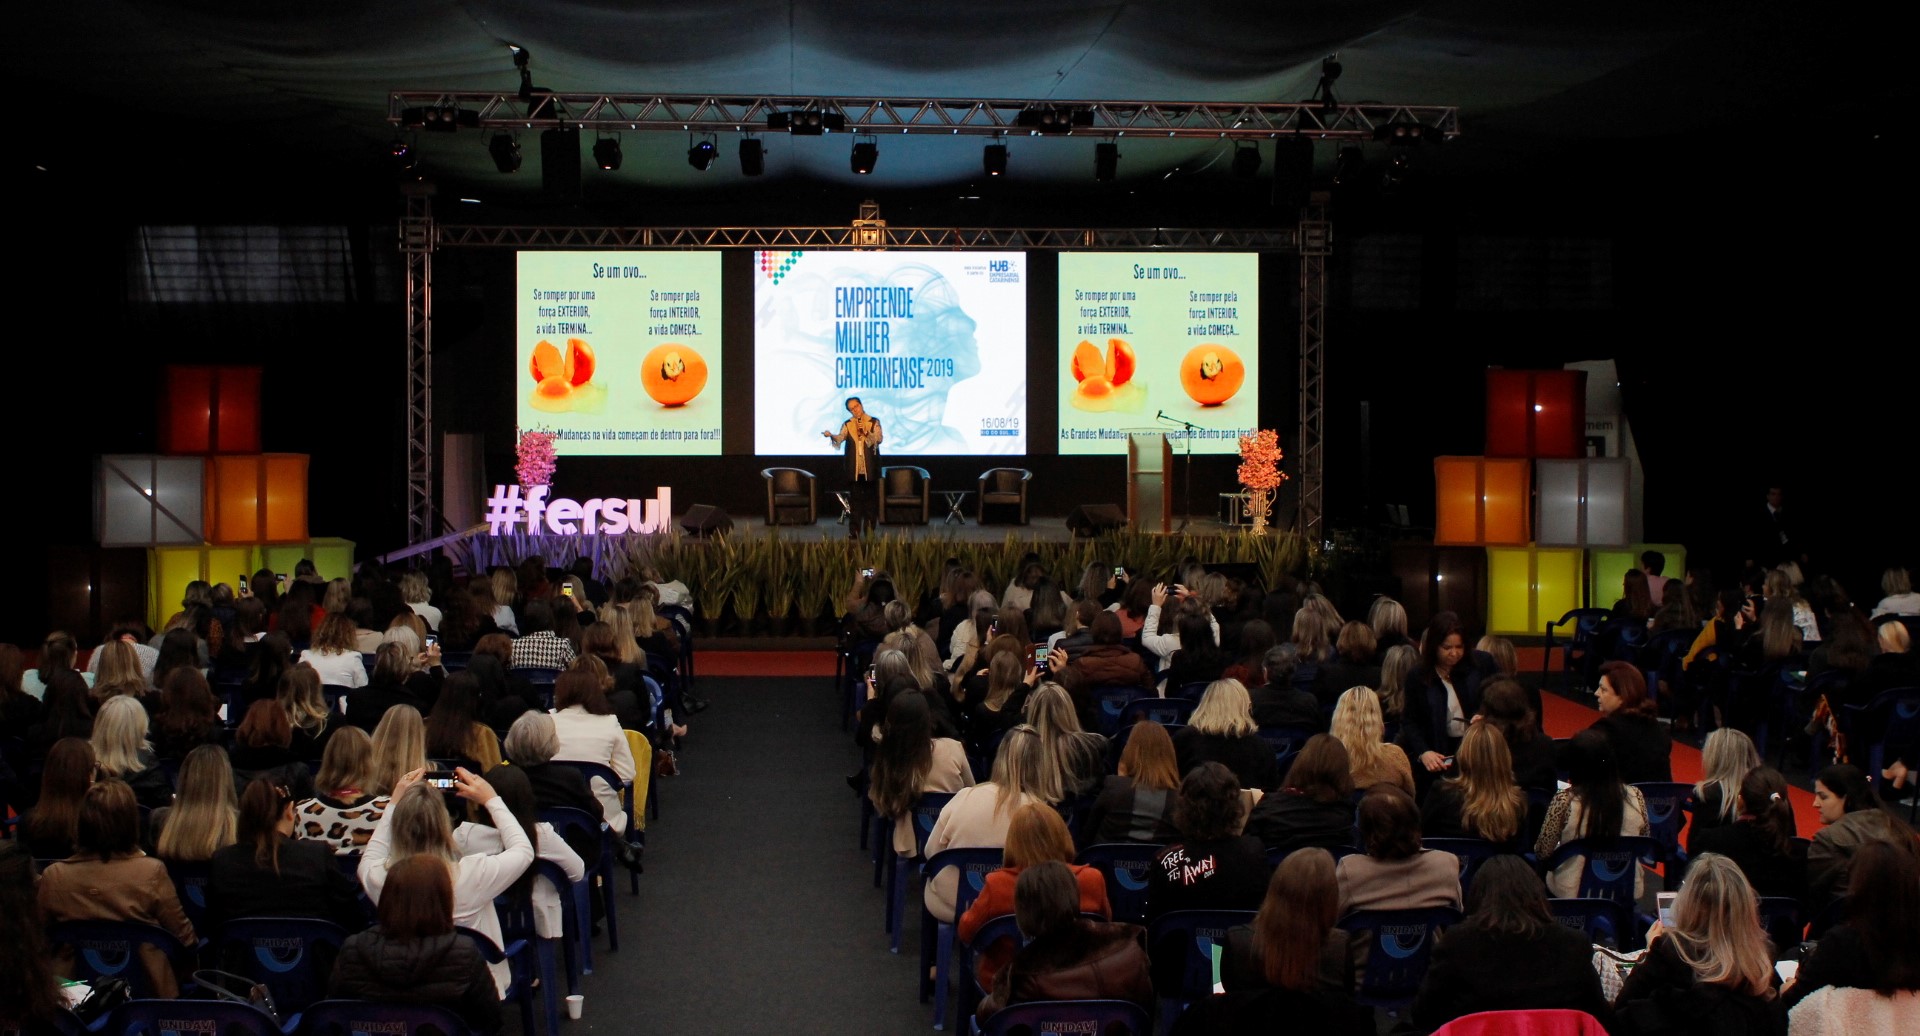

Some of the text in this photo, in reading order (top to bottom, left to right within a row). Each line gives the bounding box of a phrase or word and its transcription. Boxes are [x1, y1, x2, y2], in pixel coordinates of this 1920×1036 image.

[592, 262, 647, 279] Se um ovo...
[989, 260, 1009, 272] HUB
[1133, 263, 1186, 280] Se um ovo...
[533, 288, 596, 303] Se romper por uma
[650, 289, 700, 304] Se romper pela
[835, 286, 914, 319] EMPREENDE
[1075, 288, 1136, 303] Se romper por uma
[1189, 290, 1238, 305] Se romper pela
[538, 305, 591, 320] força EXTERIOR,
[649, 306, 701, 321] força INTERIOR,
[1080, 306, 1131, 321] força EXTERIOR,
[1188, 307, 1239, 321] força INTERIOR,
[536, 322, 593, 335] a vida TERMINA...
[648, 326, 653, 336] a
[653, 323, 669, 336] vida
[1077, 322, 1134, 335] a vida TERMINA...
[1187, 326, 1192, 336] a
[1193, 324, 1207, 336] vida
[835, 321, 890, 354] MULHER
[835, 356, 954, 389] CATARINENSE 2019
[981, 417, 1019, 429] 16/08/19
[558, 428, 591, 442] Mudanças
[592, 431, 600, 441] na
[601, 428, 616, 441] vida
[617, 431, 649, 442] começam
[650, 428, 659, 441] de
[660, 428, 682, 441] dentro
[683, 431, 699, 443] para
[700, 428, 721, 440] fora!!!
[1061, 428, 1069, 440] As
[1070, 428, 1097, 440] Grandes
[1098, 428, 1128, 442] Mudança
[1198, 429, 1220, 439] dentro
[1221, 430, 1236, 441] para
[485, 484, 671, 536] #fersul
[1161, 849, 1184, 869] FREE
[1167, 855, 1213, 885] FLY AWAY
[158, 1019, 216, 1031] UNIDAVI
[1041, 1020, 1097, 1032] UNIDAVI
